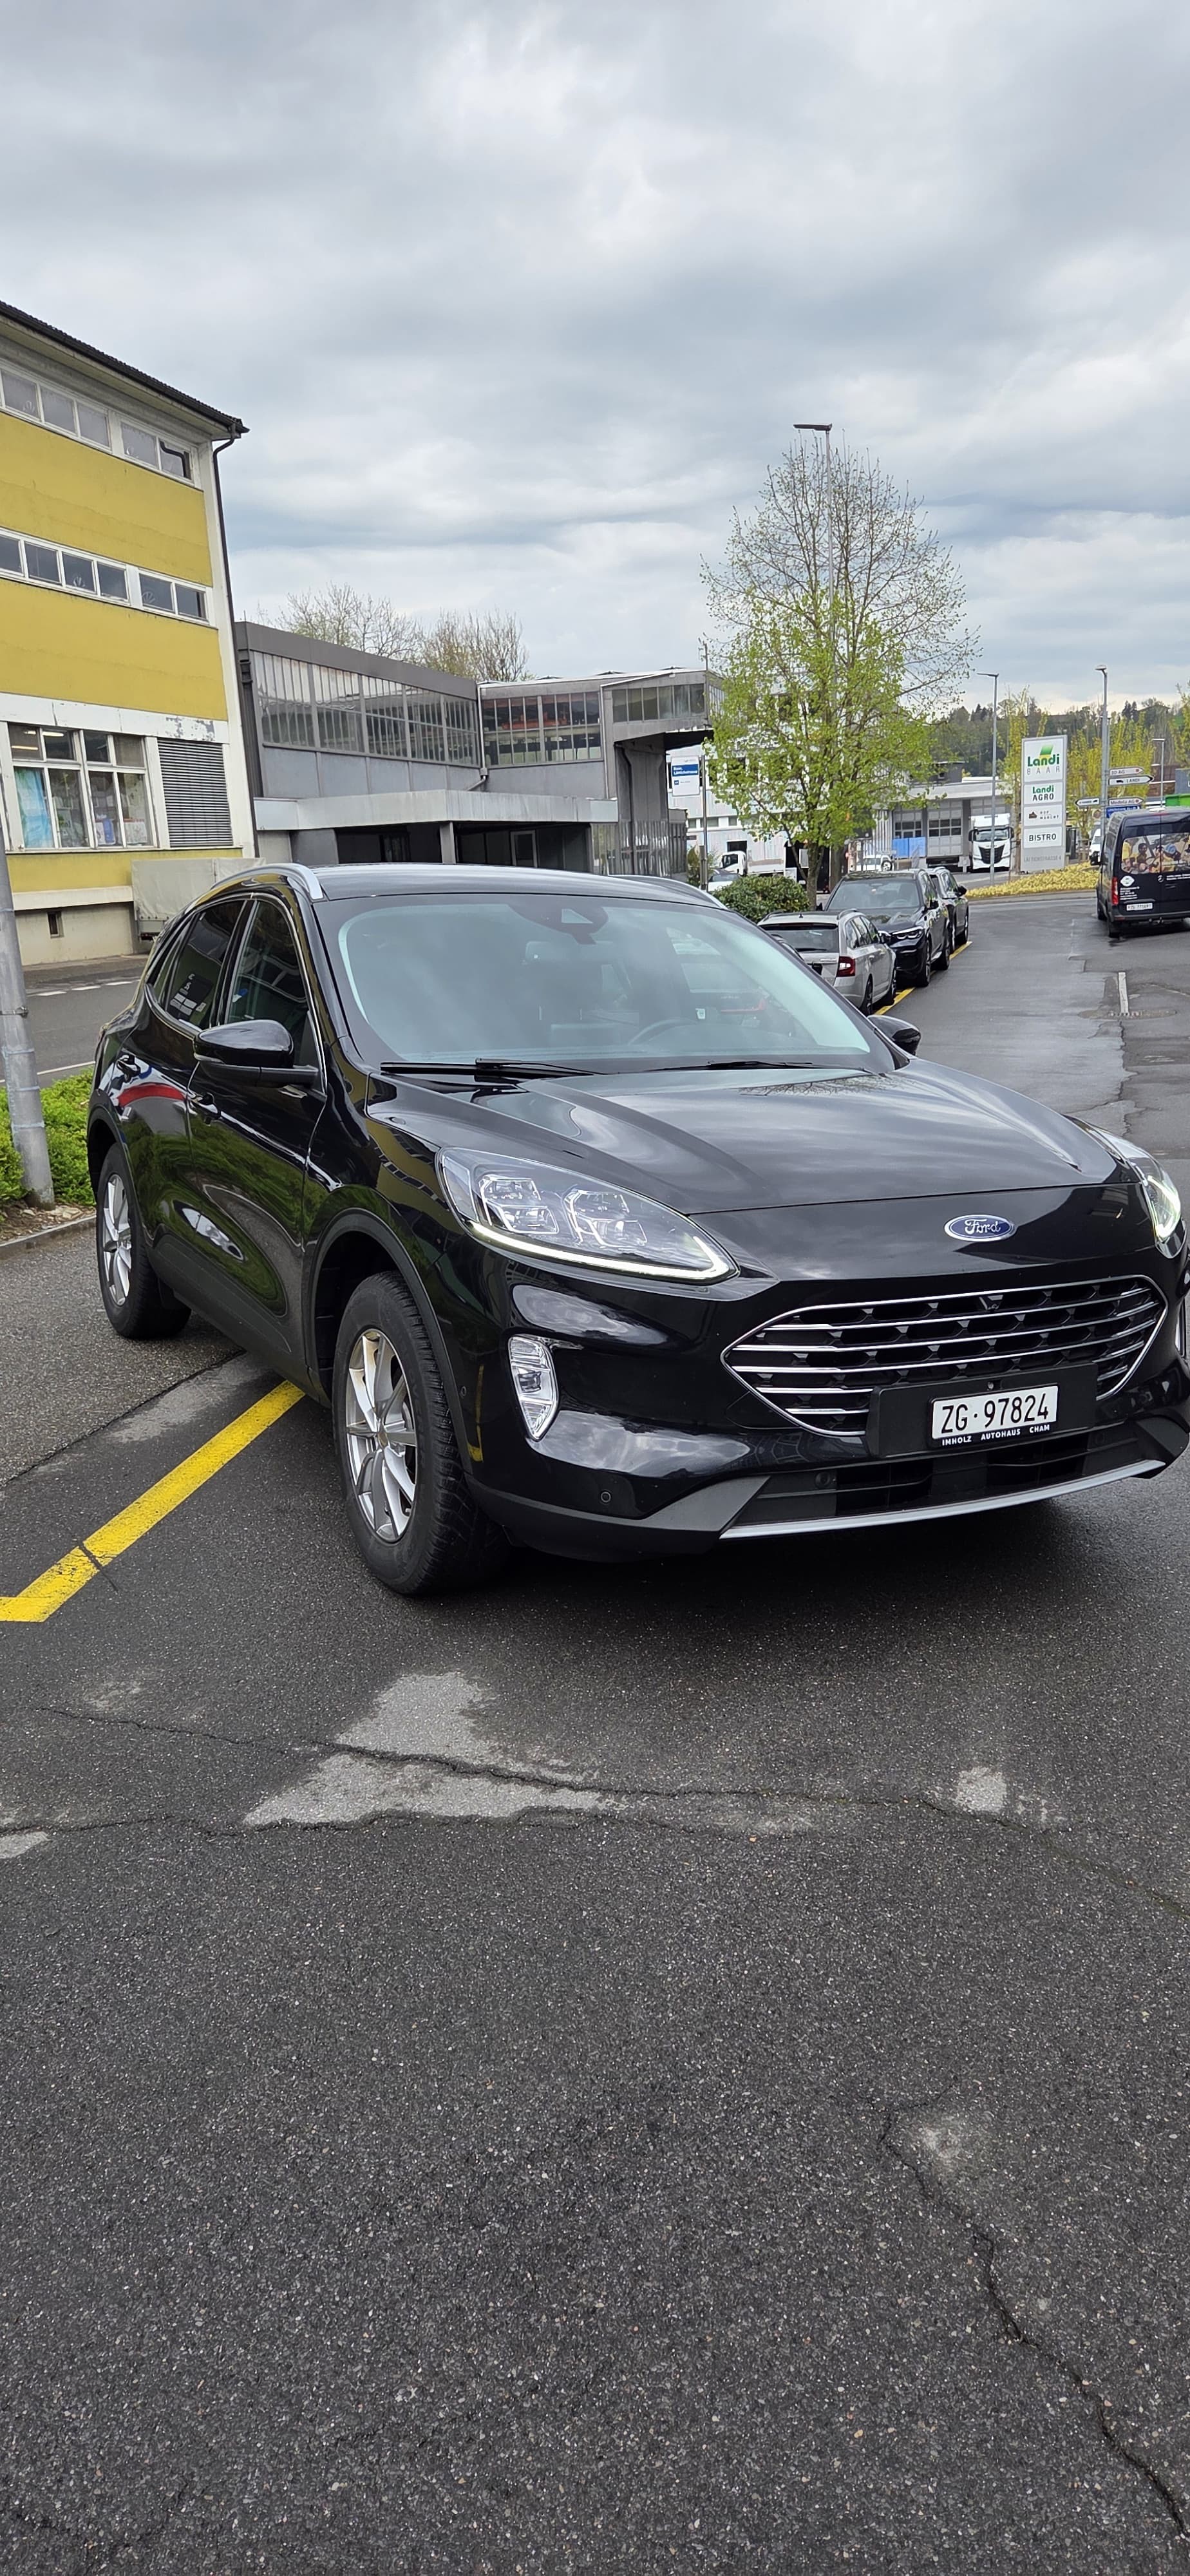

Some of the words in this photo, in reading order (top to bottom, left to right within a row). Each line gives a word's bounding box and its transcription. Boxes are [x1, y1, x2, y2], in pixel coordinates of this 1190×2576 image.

[1027, 753, 1060, 766] Landi
[1027, 766, 1060, 775] BAAR
[1032, 785, 1054, 794] Landi
[1029, 833, 1057, 842] BISTRO
[965, 1218, 1001, 1235] Ford
[942, 1435, 972, 1446] IMHOLZ
[981, 1428, 1021, 1441] AUTOHAUS
[1029, 1424, 1050, 1434] CHAM
